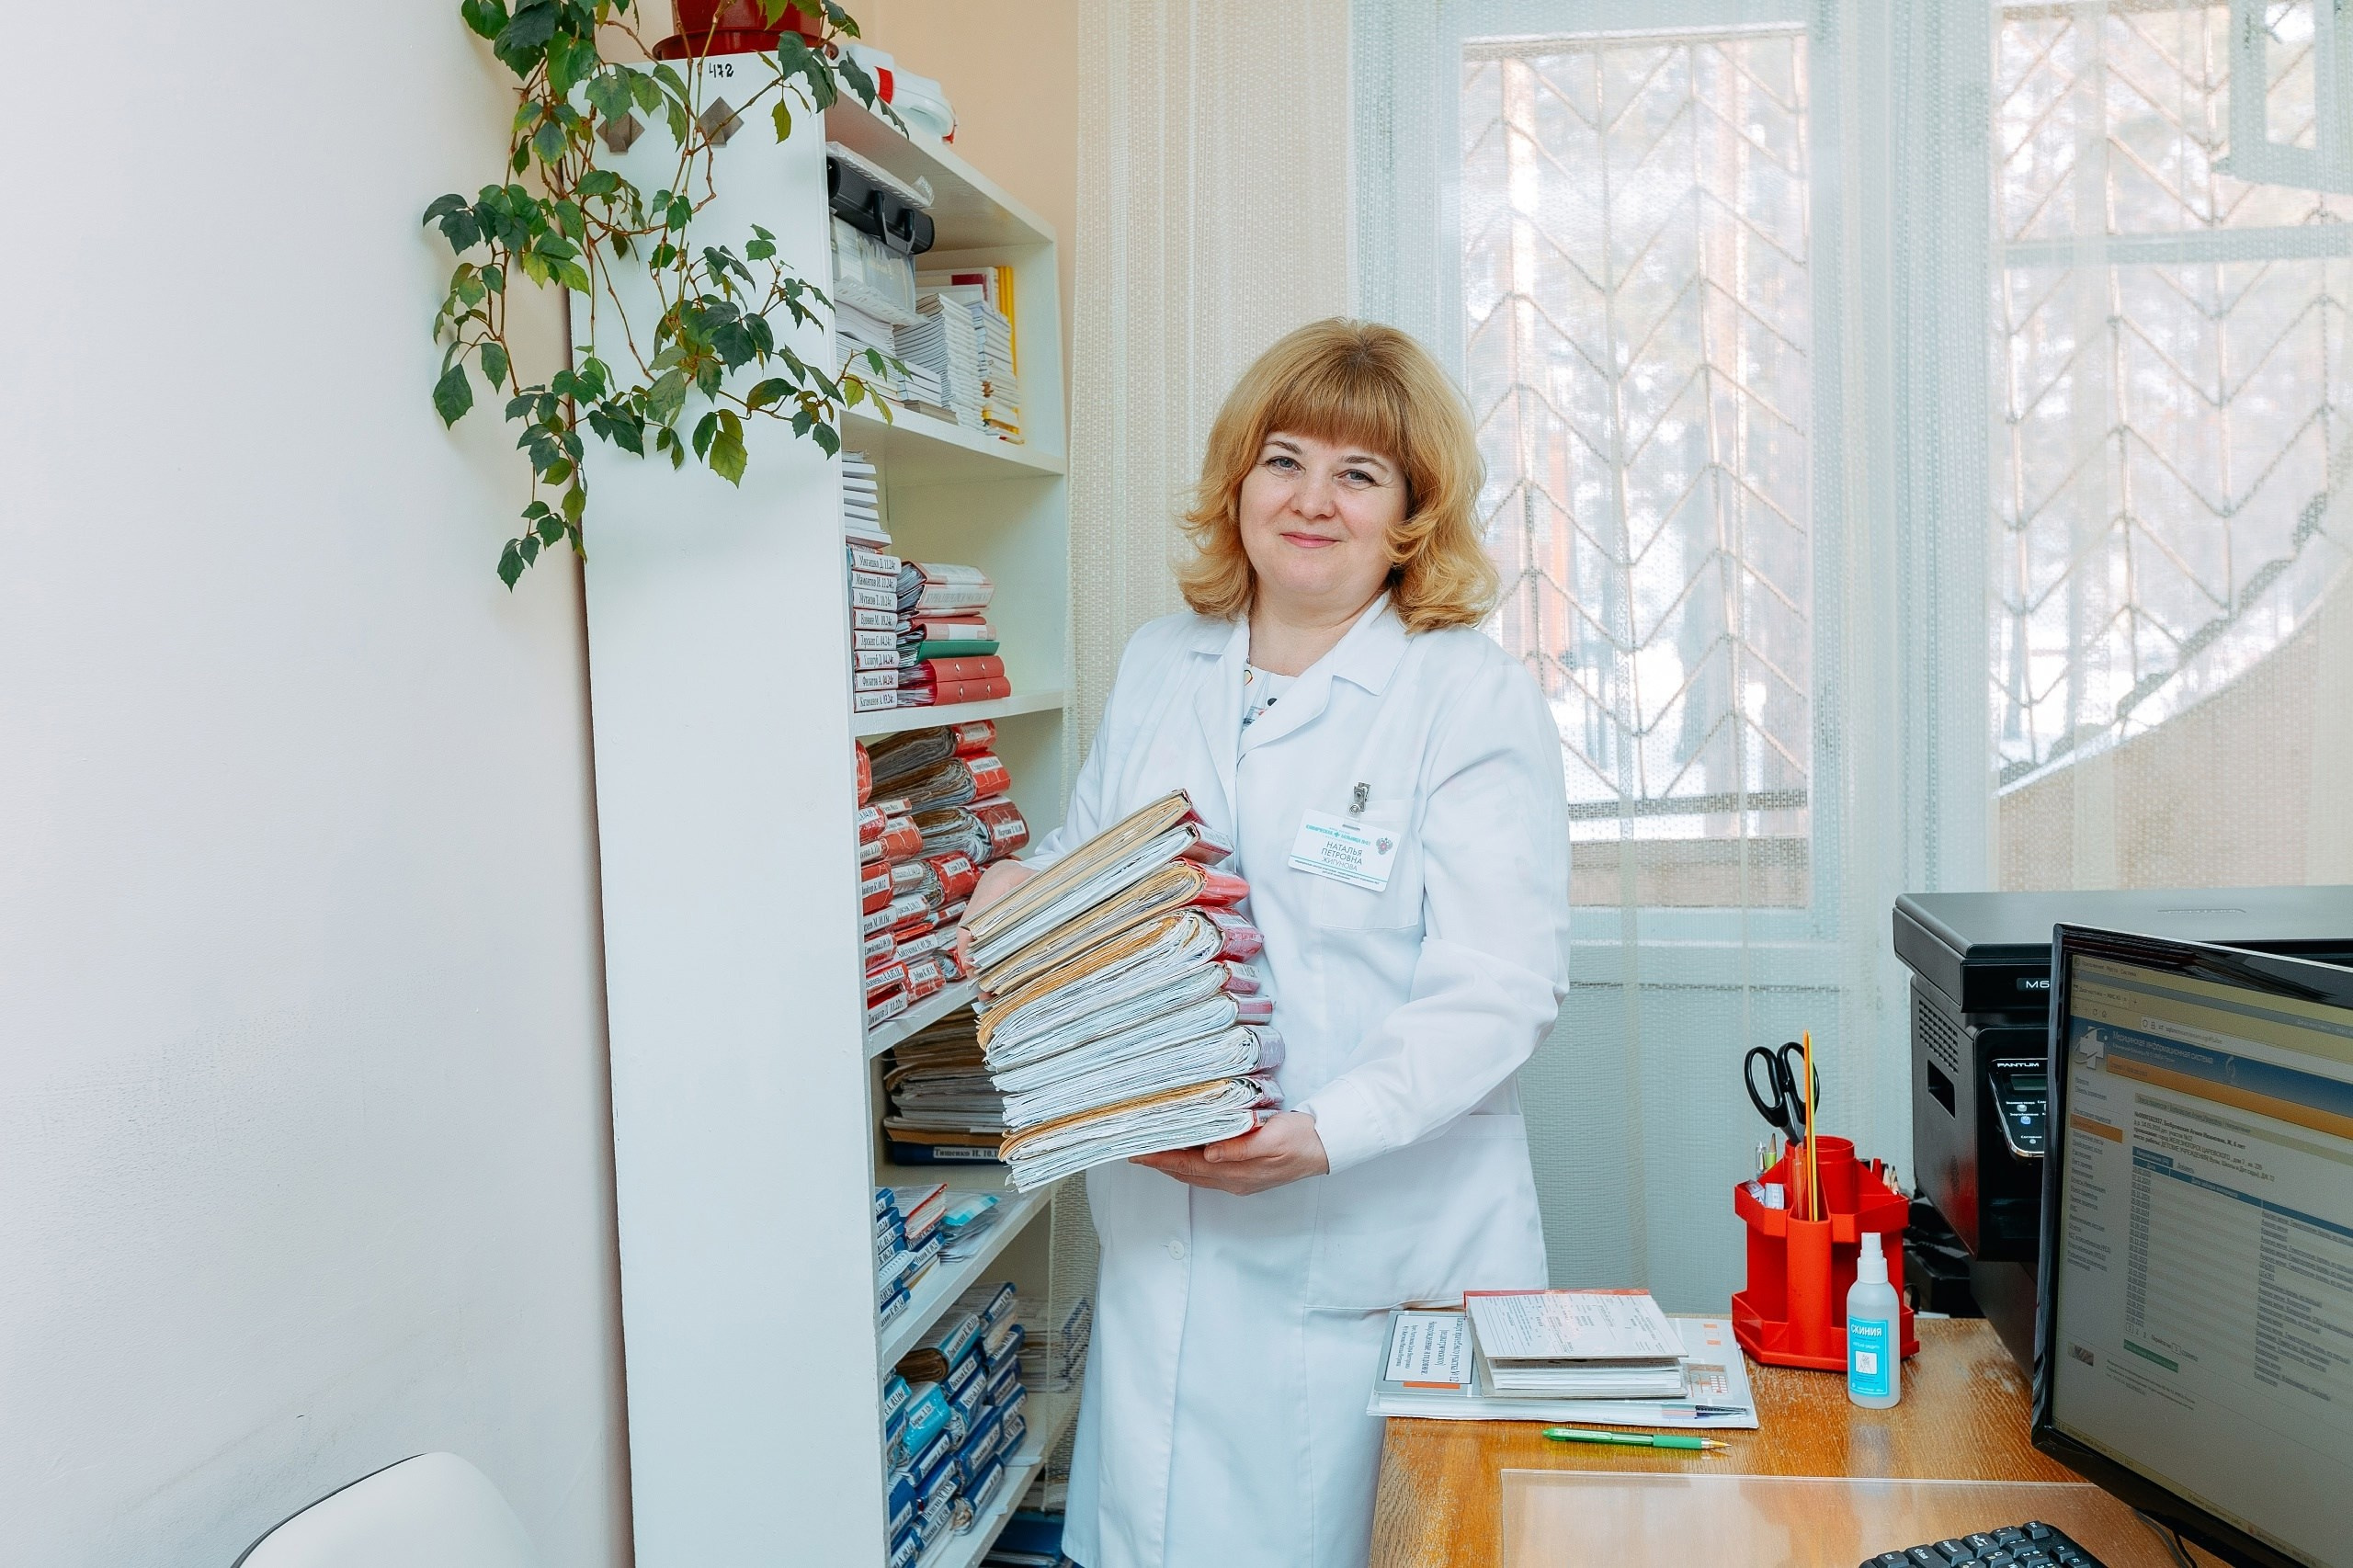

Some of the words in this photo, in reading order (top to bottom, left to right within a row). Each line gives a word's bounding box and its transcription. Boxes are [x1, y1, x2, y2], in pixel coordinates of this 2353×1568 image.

[709, 62, 734, 78] 472
[1321, 847, 1362, 866] ПЕТРОВНА
[1326, 841, 1363, 857] НАТАЛЬЯ
[1322, 857, 1358, 871] ЖИГУНОВА
[2113, 1031, 2145, 1046] Медицинская
[2146, 1040, 2191, 1059] информационная
[2190, 1053, 2213, 1064] система
[1851, 1324, 1882, 1336] СКИНИЯ
[1449, 1355, 1460, 1370] участка
